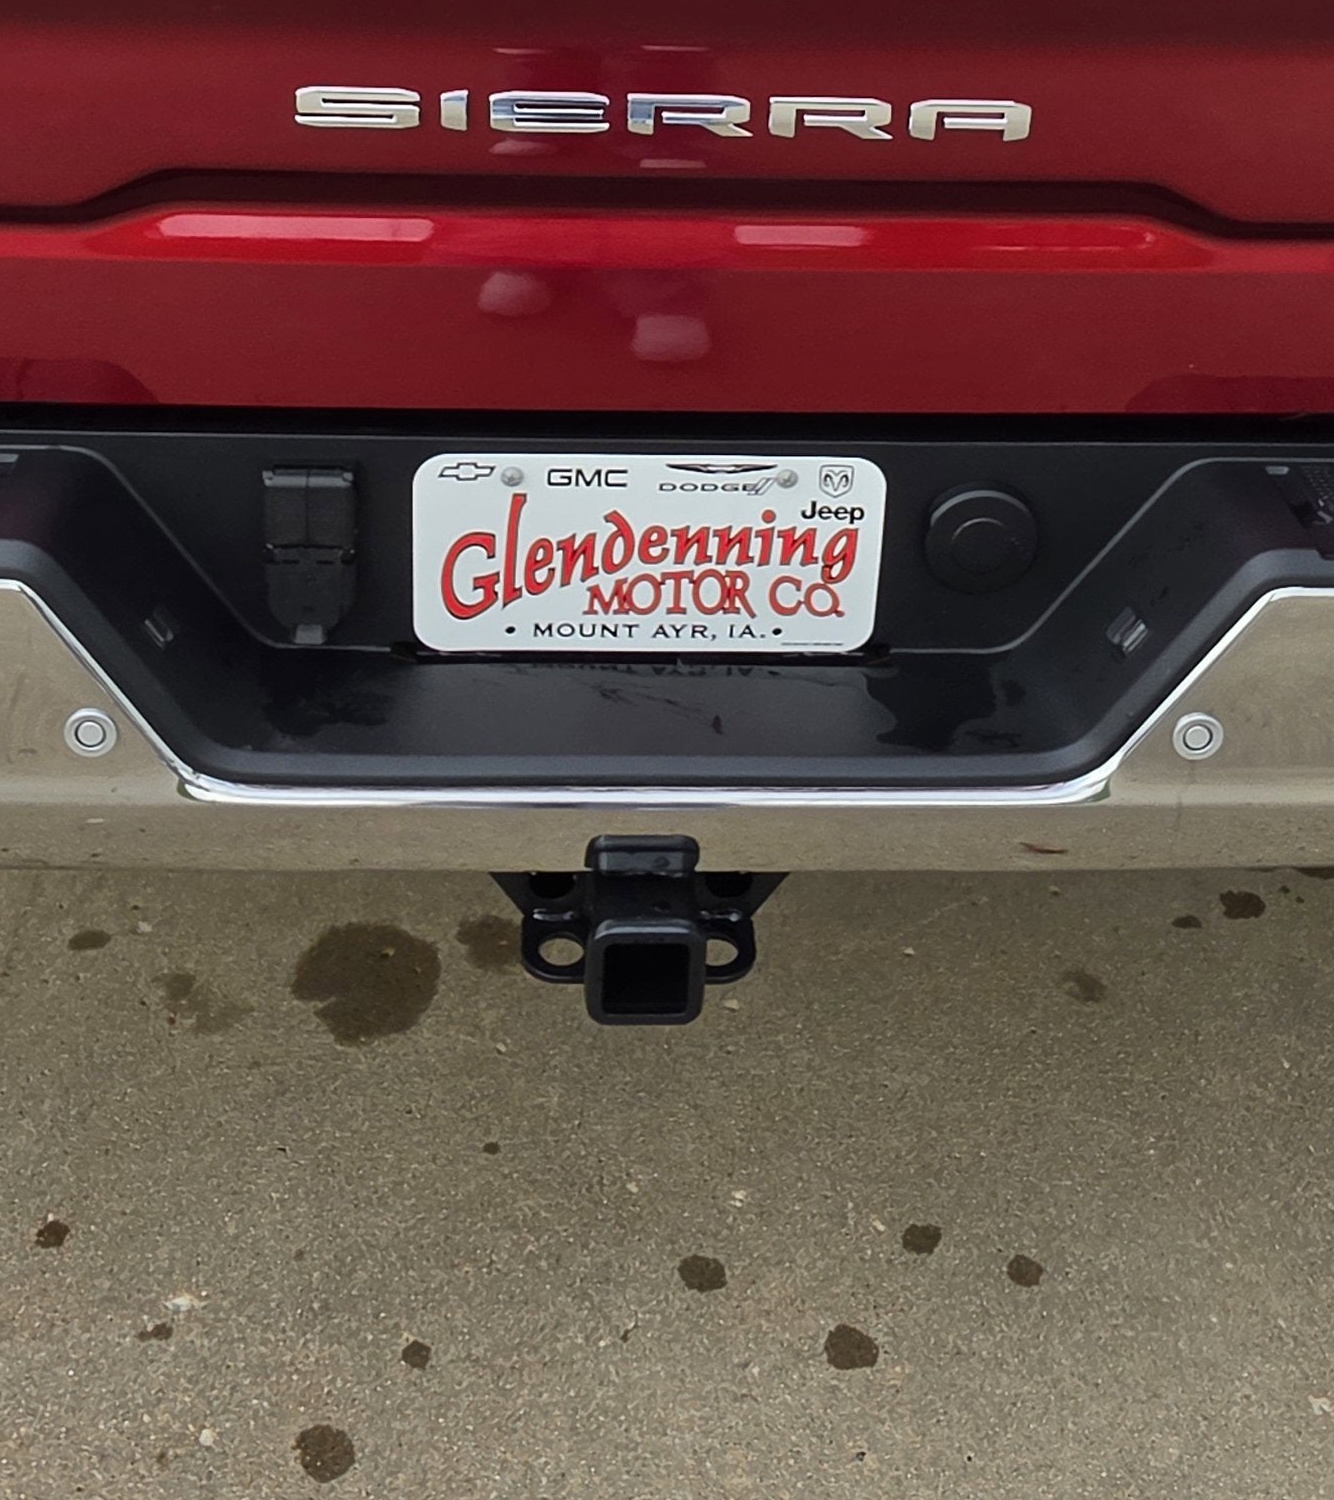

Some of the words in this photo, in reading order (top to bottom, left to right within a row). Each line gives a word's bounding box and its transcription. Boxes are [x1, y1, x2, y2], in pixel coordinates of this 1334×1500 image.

[295, 86, 1032, 141] SIERRA
[547, 468, 629, 488] GMC
[659, 482, 757, 493] DODGE
[801, 501, 865, 524] Jeep
[440, 492, 859, 620] Glendenning
[583, 568, 756, 618] MOTOR
[533, 623, 640, 639] MOUNT
[651, 624, 717, 641] AYR,
